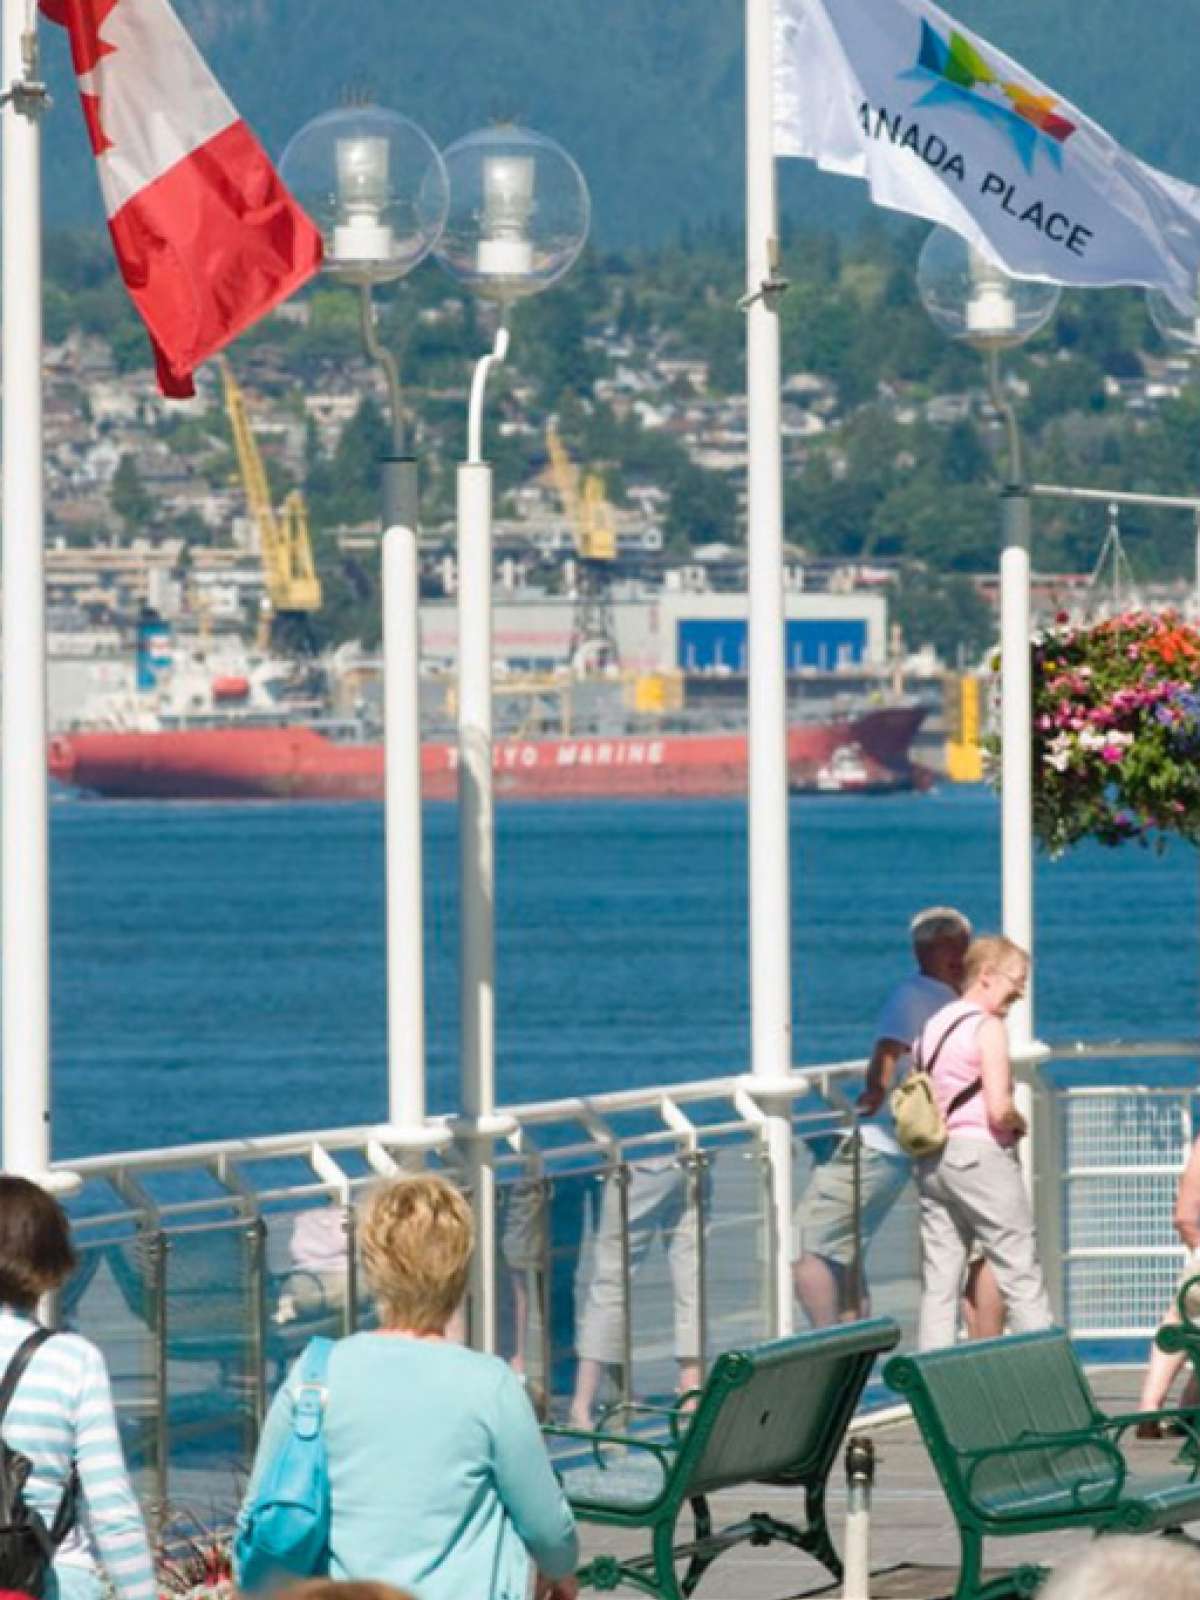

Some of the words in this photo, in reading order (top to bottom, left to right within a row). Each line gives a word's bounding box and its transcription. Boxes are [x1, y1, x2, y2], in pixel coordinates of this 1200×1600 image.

[859, 102, 965, 181] ANADA
[980, 172, 1094, 257] PLACE
[446, 747, 538, 768] TYO
[558, 741, 664, 765] MARINE
